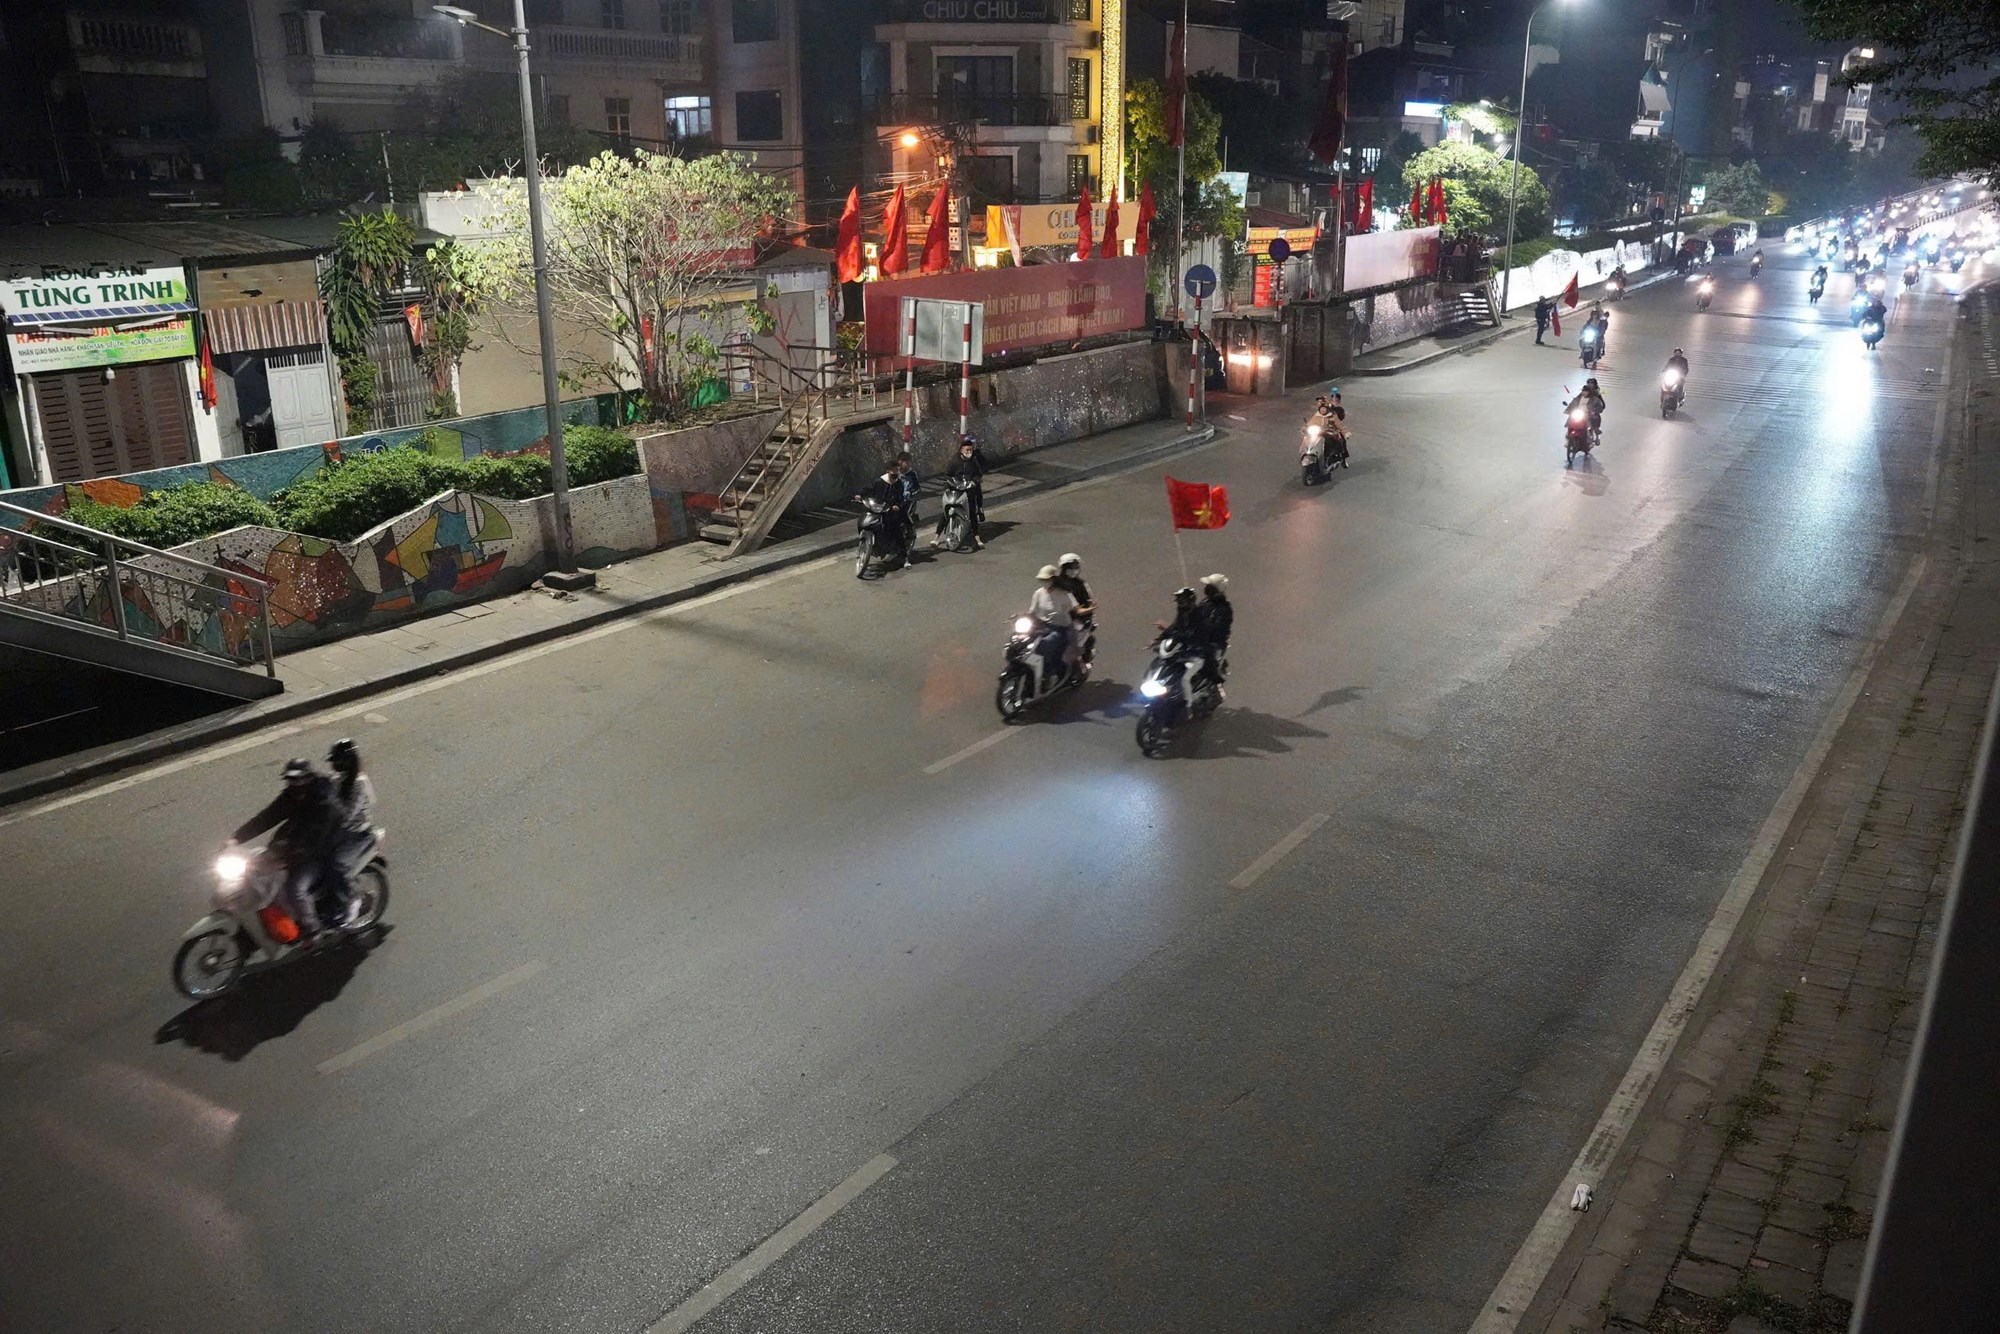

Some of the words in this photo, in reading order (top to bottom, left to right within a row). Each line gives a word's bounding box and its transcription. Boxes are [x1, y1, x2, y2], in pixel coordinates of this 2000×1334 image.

[15, 283, 91, 308] TÙNG
[97, 281, 174, 303] TRINH
[1000, 292, 1019, 316] VIỆT
[1020, 293, 1041, 312] NAM
[1018, 316, 1036, 339] CỦA
[1037, 315, 1059, 336] CÁCH
